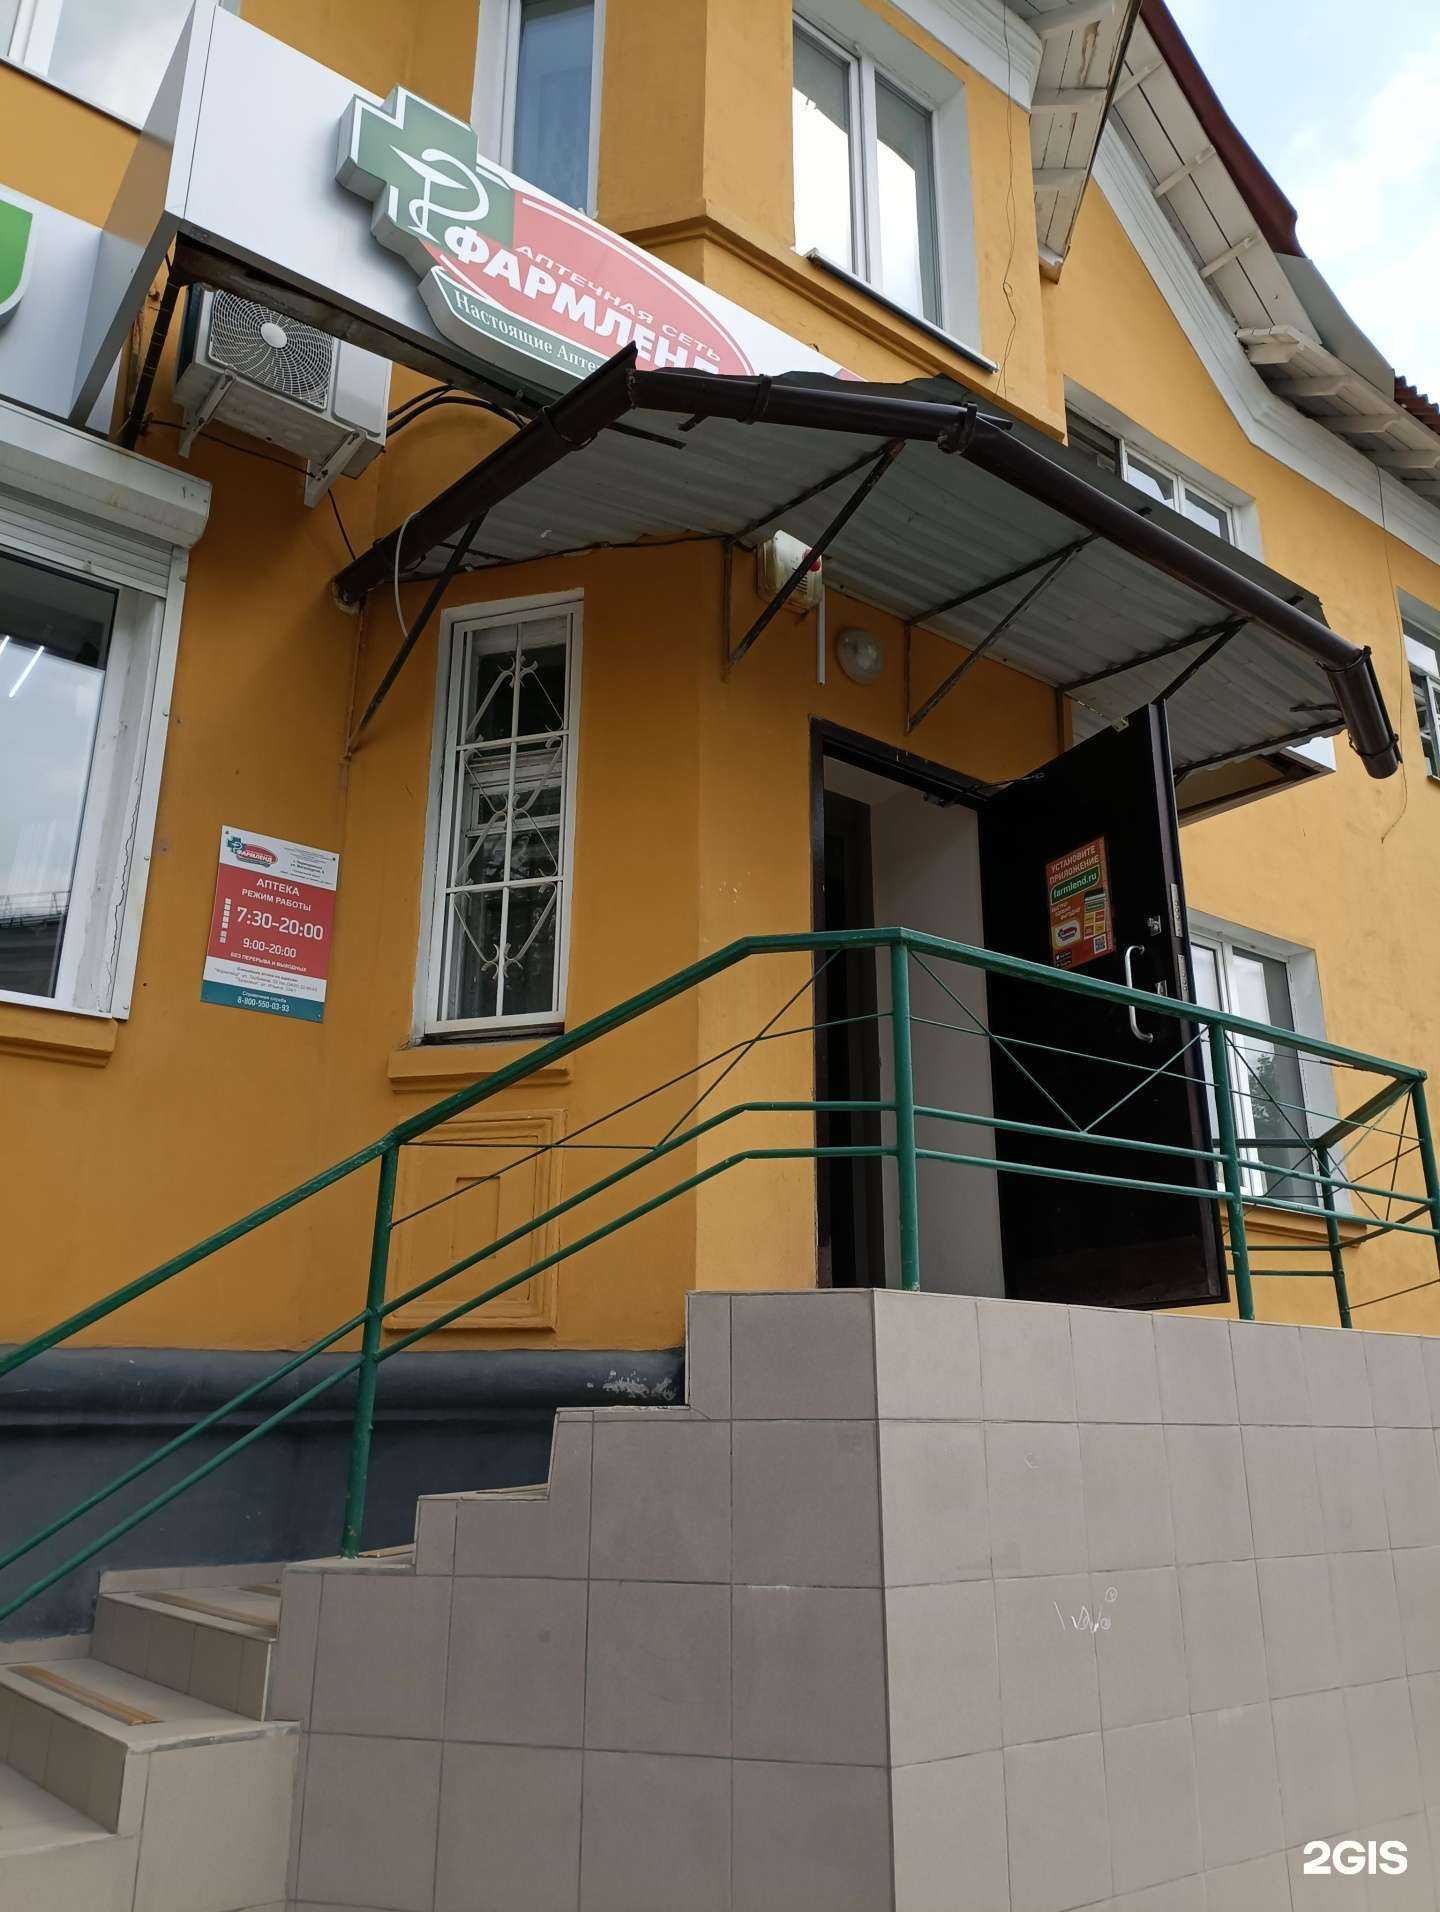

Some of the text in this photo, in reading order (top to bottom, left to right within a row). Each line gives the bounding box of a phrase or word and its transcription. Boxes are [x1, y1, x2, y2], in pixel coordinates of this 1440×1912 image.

[514, 246, 721, 362] АПТЕЧНАЯ СЕТЬ
[453, 289, 601, 378] Настоящие Апте
[256, 878, 300, 896] АПТЕКА
[1053, 873, 1097, 899] farmlend.ru
[241, 888, 312, 911] РЕЖИМ РАБОТЫ
[237, 906, 324, 940] 7:30-20:00
[243, 938, 297, 958] 9:00-20:00
